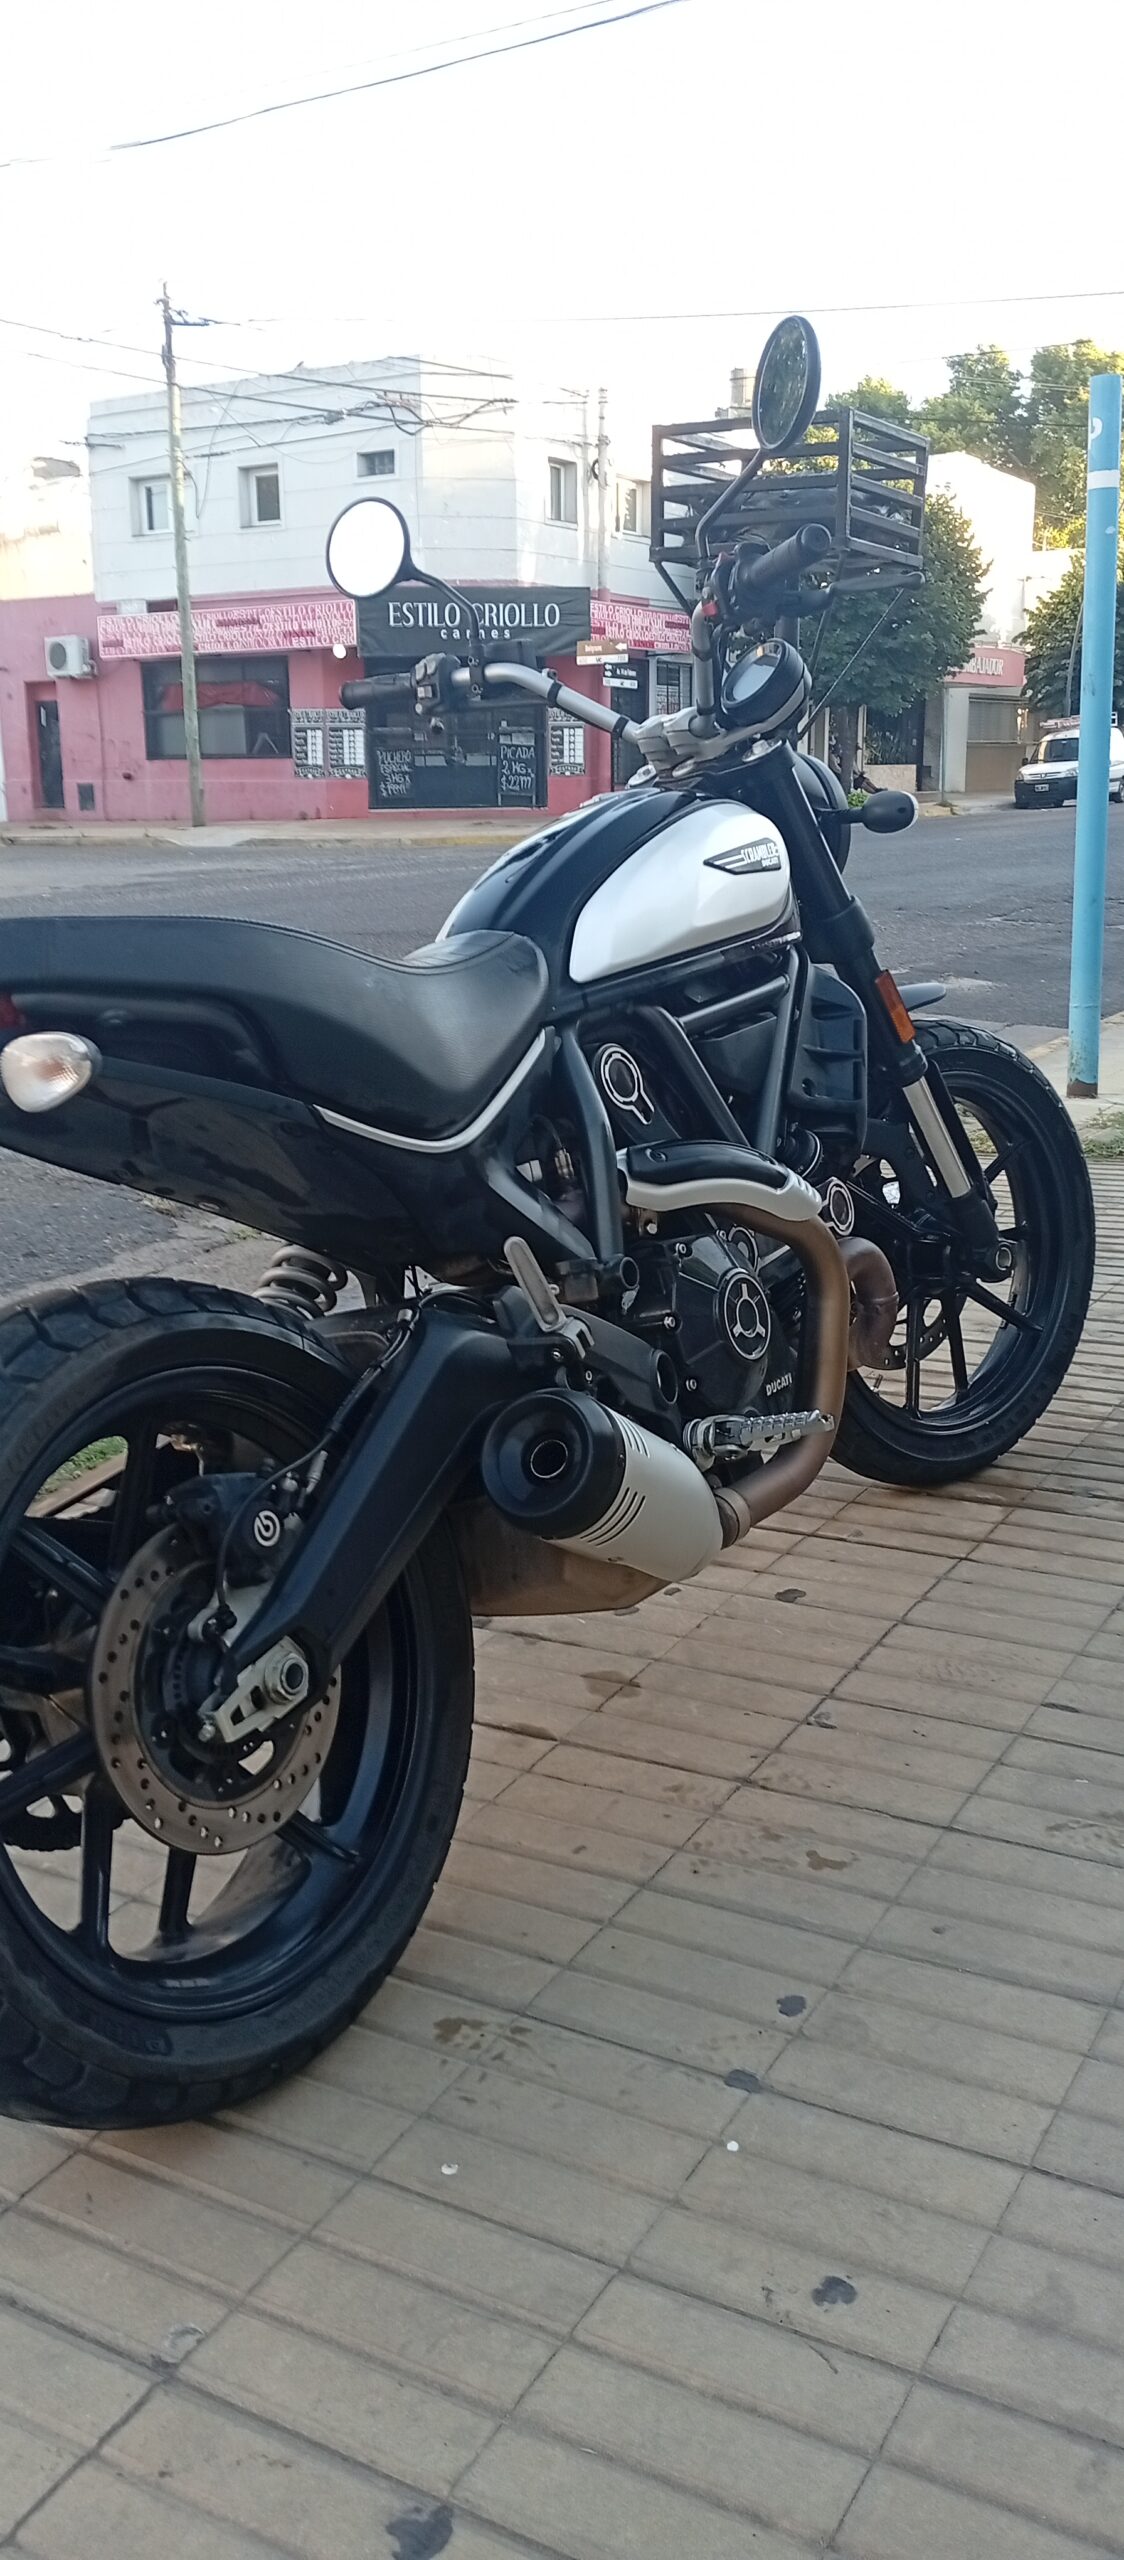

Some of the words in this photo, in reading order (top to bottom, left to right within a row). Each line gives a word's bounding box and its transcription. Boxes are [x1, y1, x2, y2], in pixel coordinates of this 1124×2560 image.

[307, 602, 354, 615] CRIOLLO
[388, 602, 461, 628] ESTILO
[472, 602, 561, 628] CRIOLLO
[440, 628, 511, 640] carnes
[500, 747, 535, 760] PICADA
[501, 760, 511, 774] 2
[740, 842, 779, 864] SCRAMBLER
[766, 1372, 792, 1396] DUCATI
